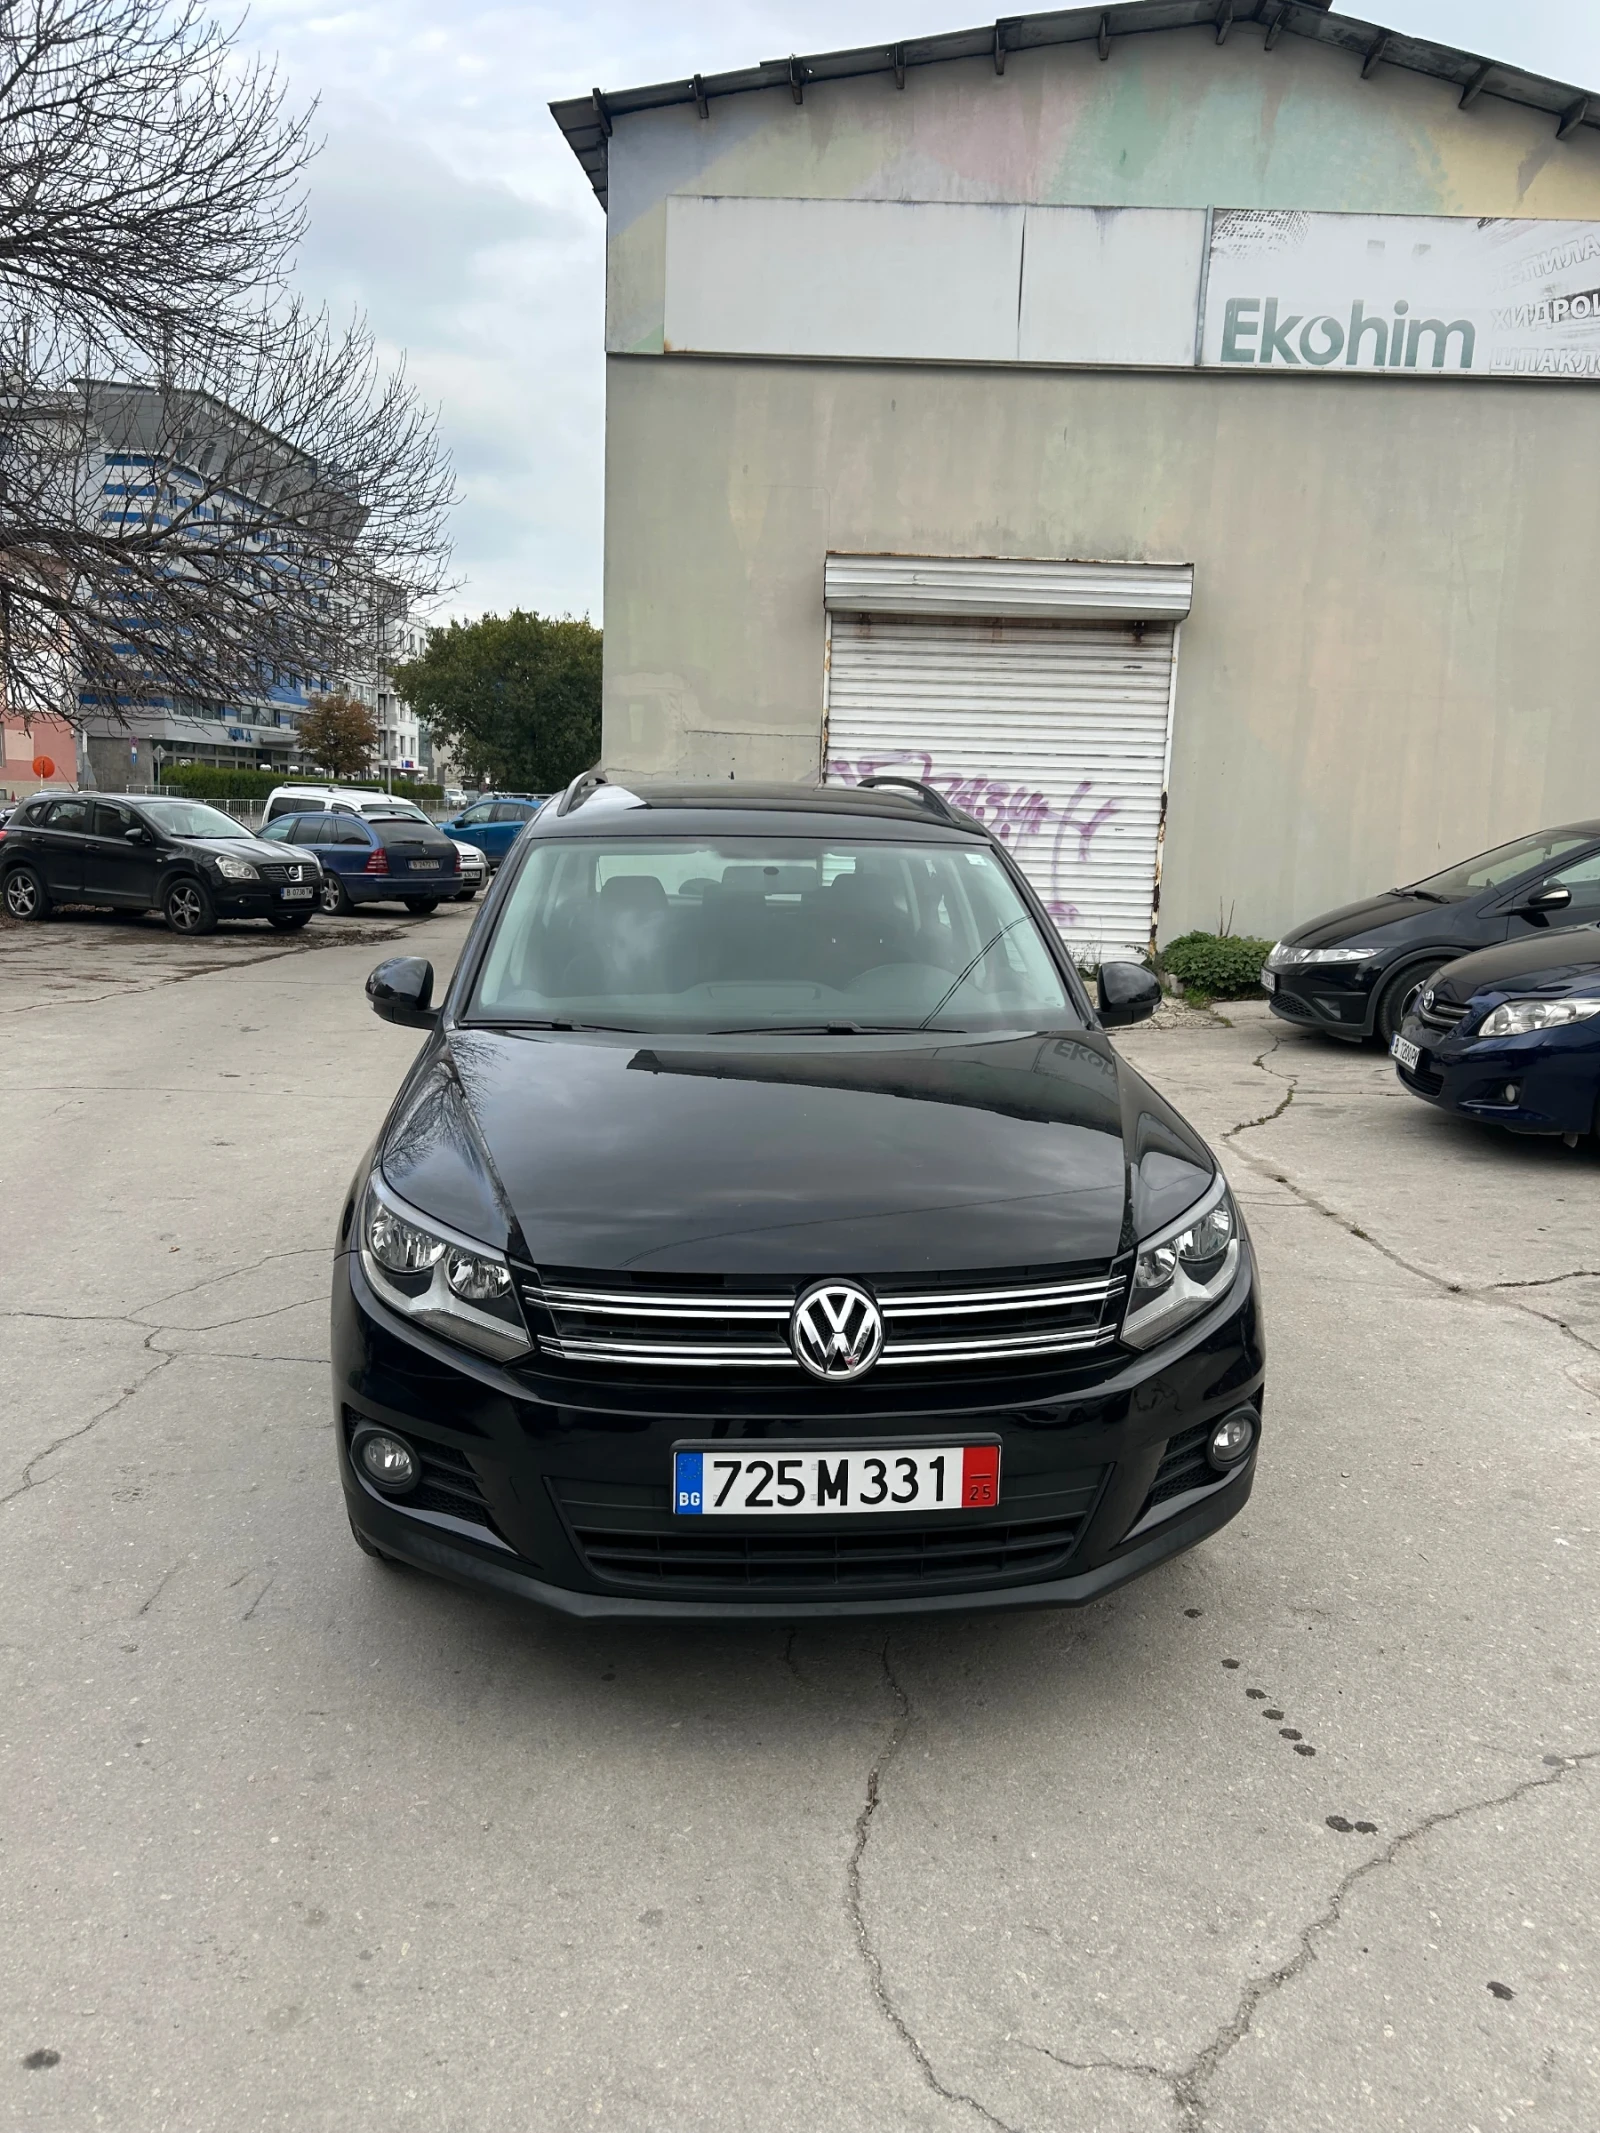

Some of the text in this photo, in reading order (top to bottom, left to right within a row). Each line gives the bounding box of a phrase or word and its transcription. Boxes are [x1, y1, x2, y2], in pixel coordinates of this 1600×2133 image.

[1220, 297, 1476, 369] Ekohim
[713, 1456, 945, 1507] 725 M 331
[969, 1484, 991, 1500] 25
[679, 1492, 701, 1507] BG
